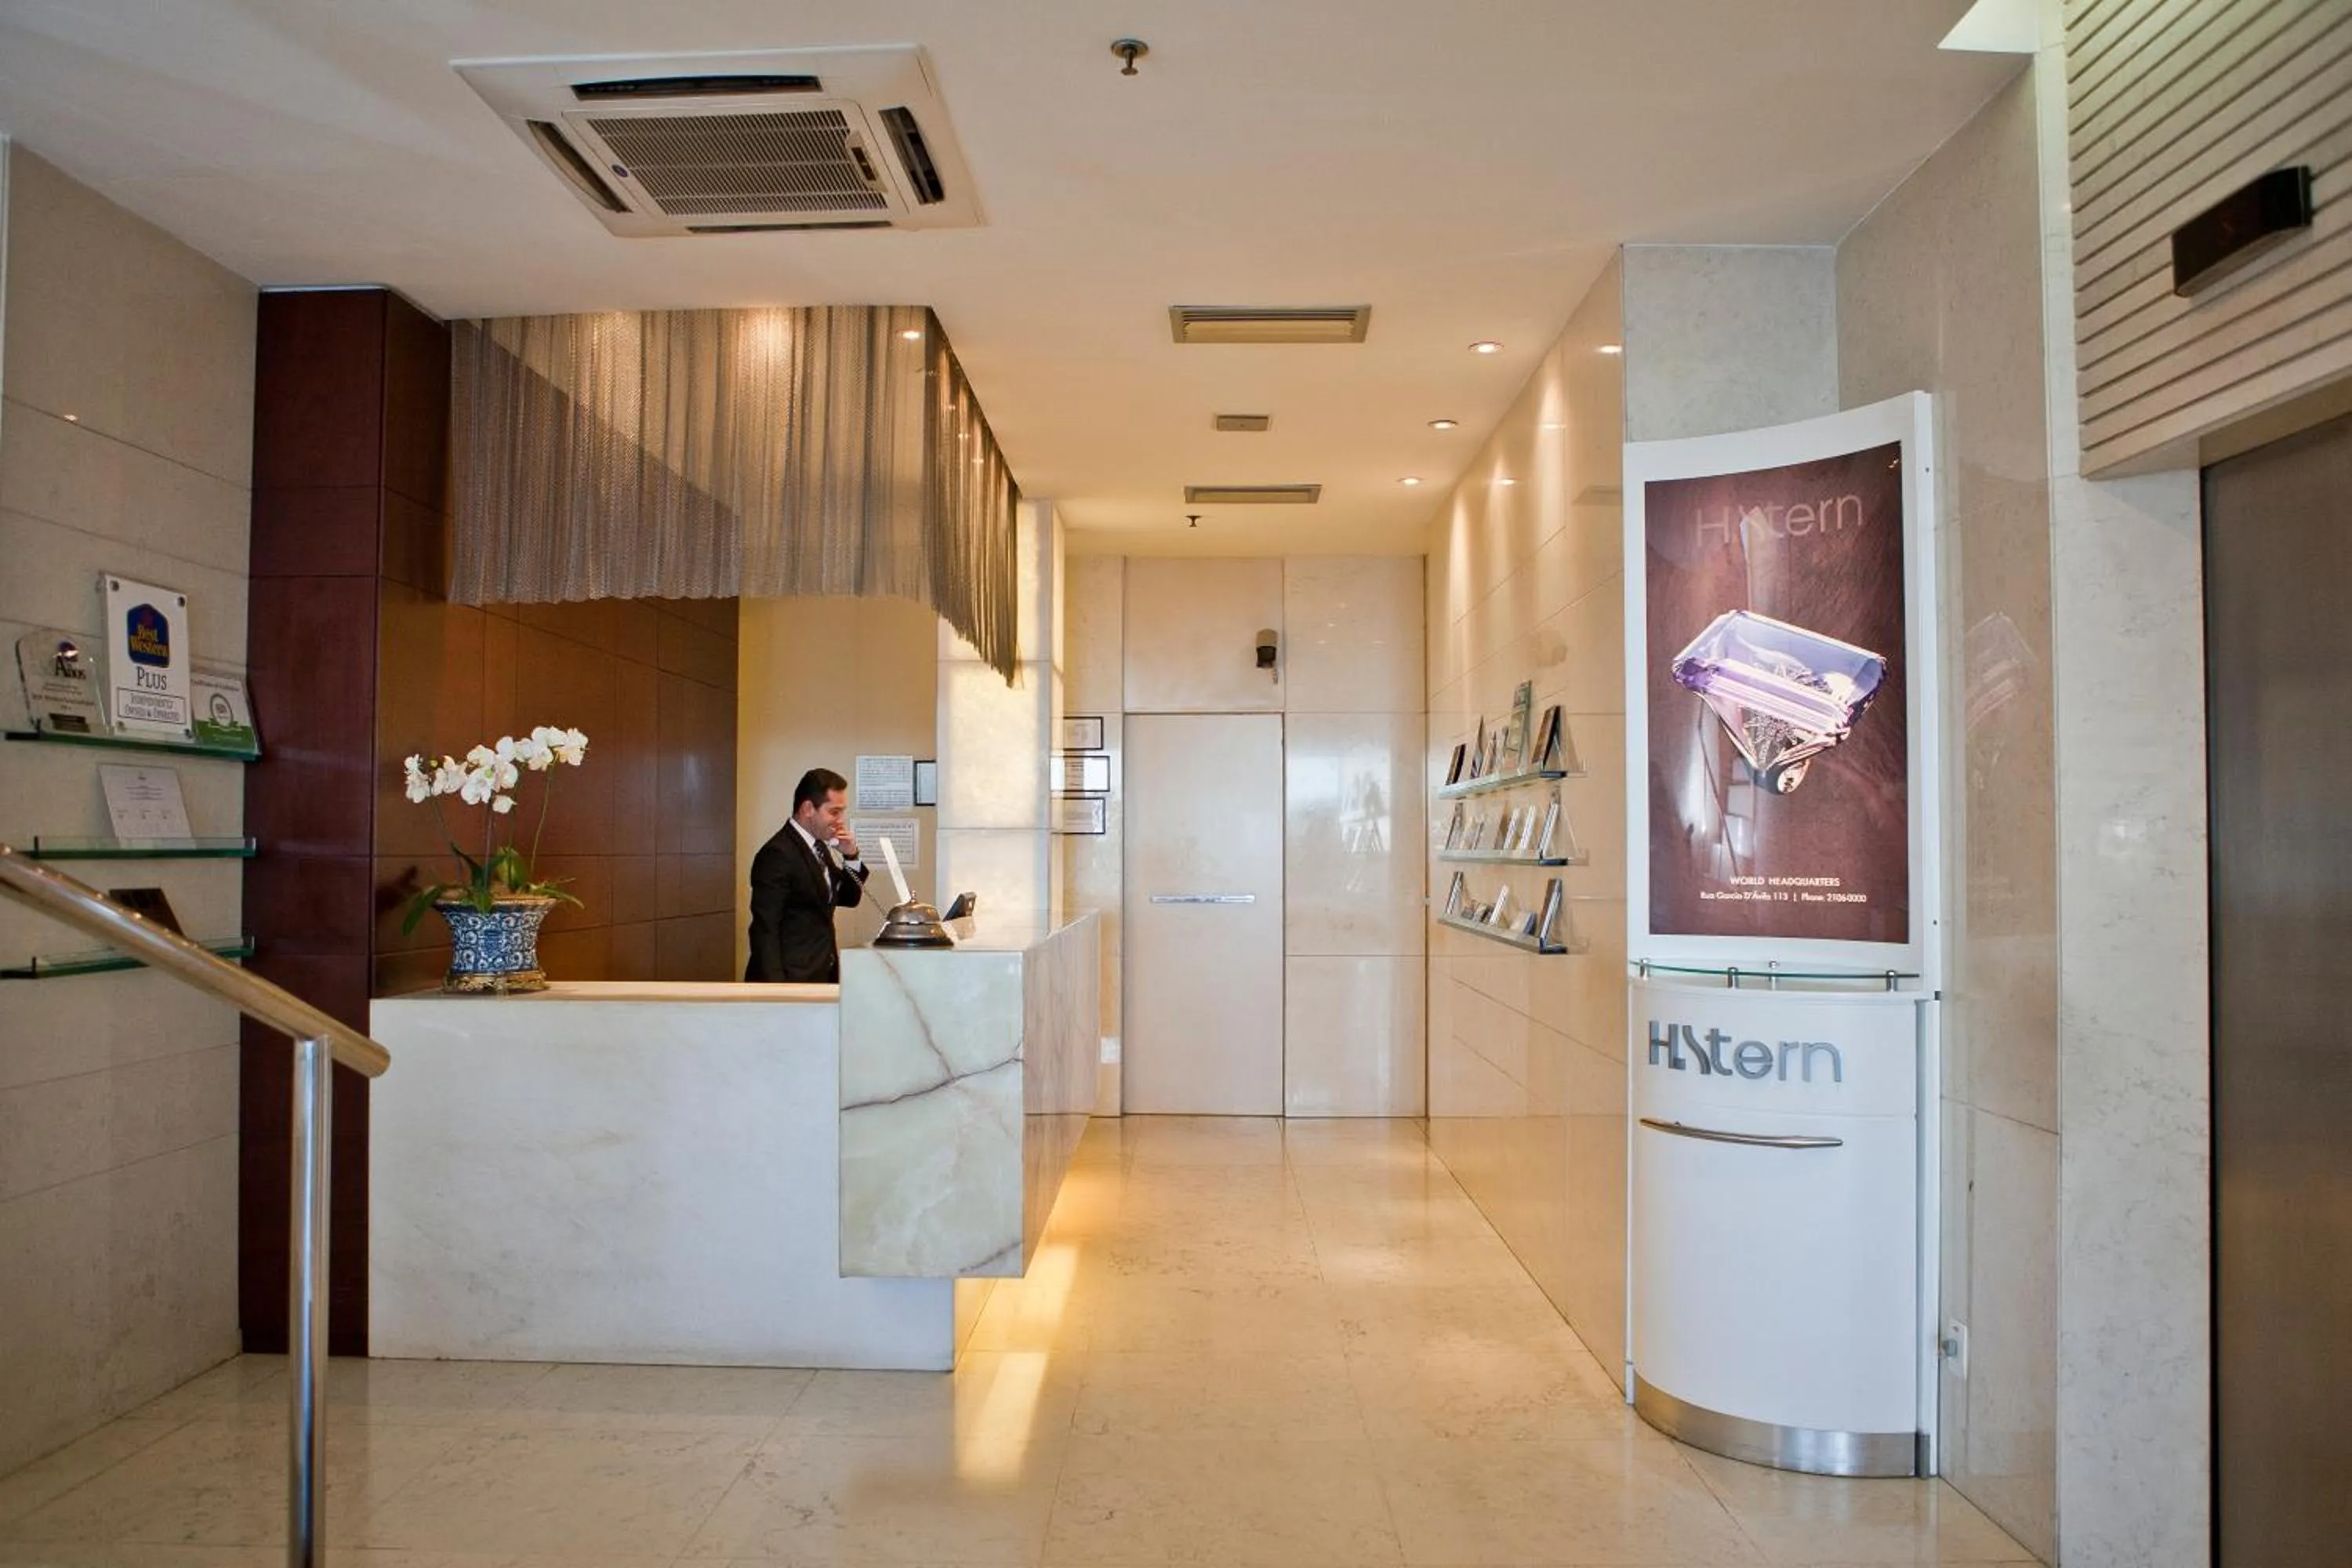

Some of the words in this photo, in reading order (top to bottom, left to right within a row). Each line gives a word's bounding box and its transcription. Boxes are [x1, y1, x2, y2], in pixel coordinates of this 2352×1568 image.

[129, 635, 169, 657] Western
[1730, 877, 1765, 885] WORLD
[1768, 877, 1840, 887] HEADQUARTERS
